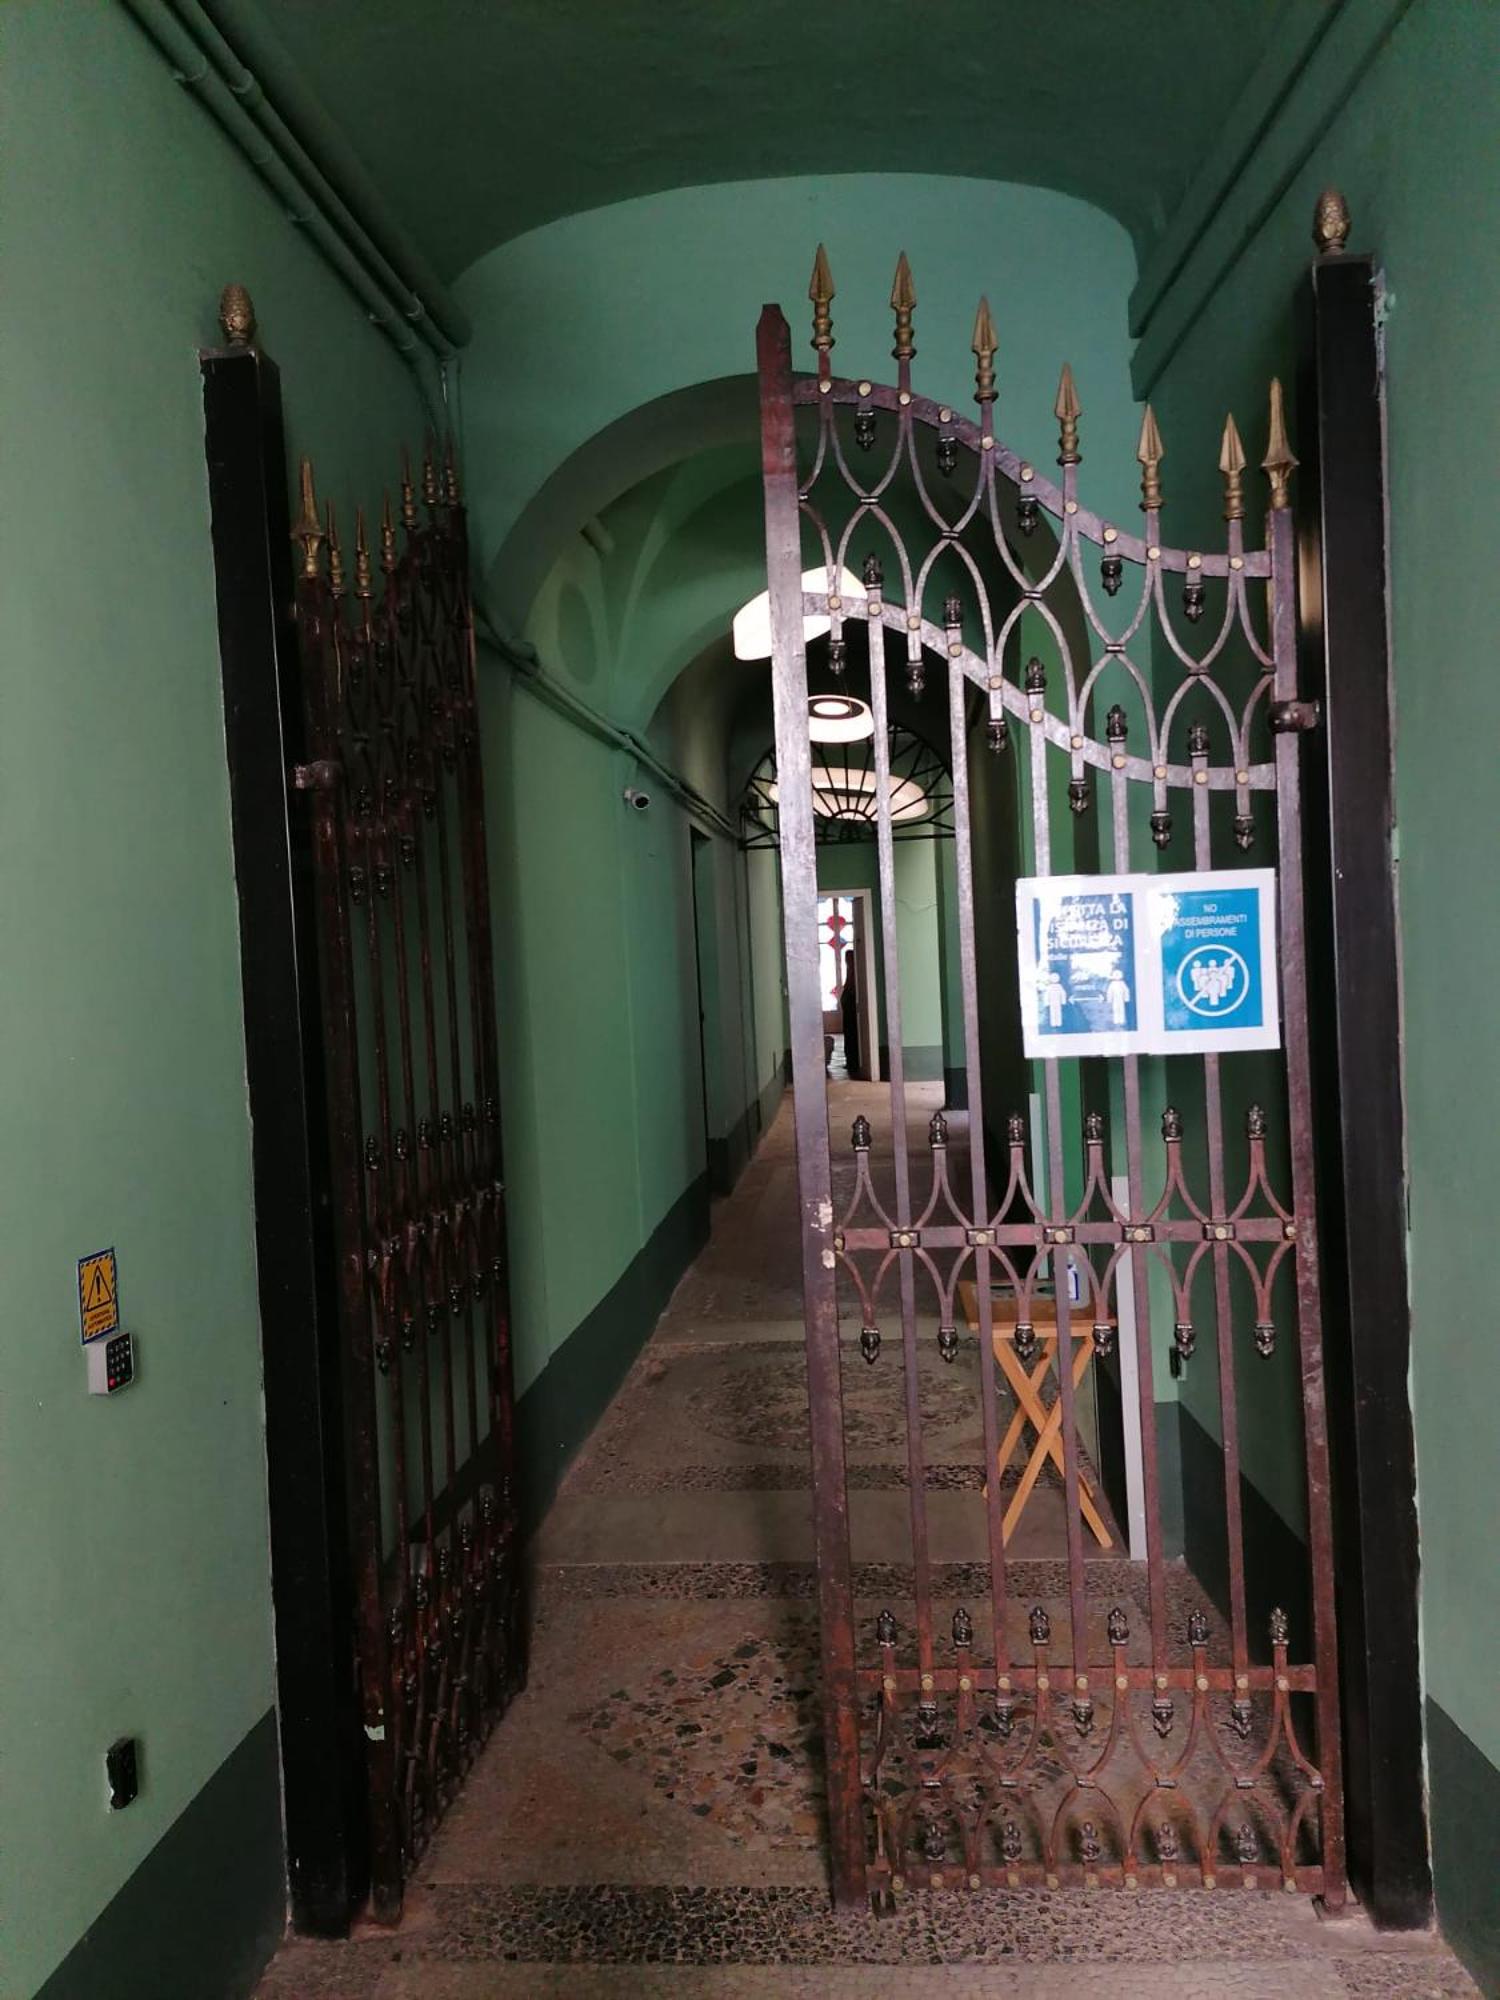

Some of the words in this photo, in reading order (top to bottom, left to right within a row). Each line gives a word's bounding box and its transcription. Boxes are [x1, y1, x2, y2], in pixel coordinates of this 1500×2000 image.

[1203, 903, 1218, 913] NO
[1113, 918, 1128, 930] DI
[1185, 928, 1194, 939] DI
[1196, 926, 1238, 938] PERSONE
